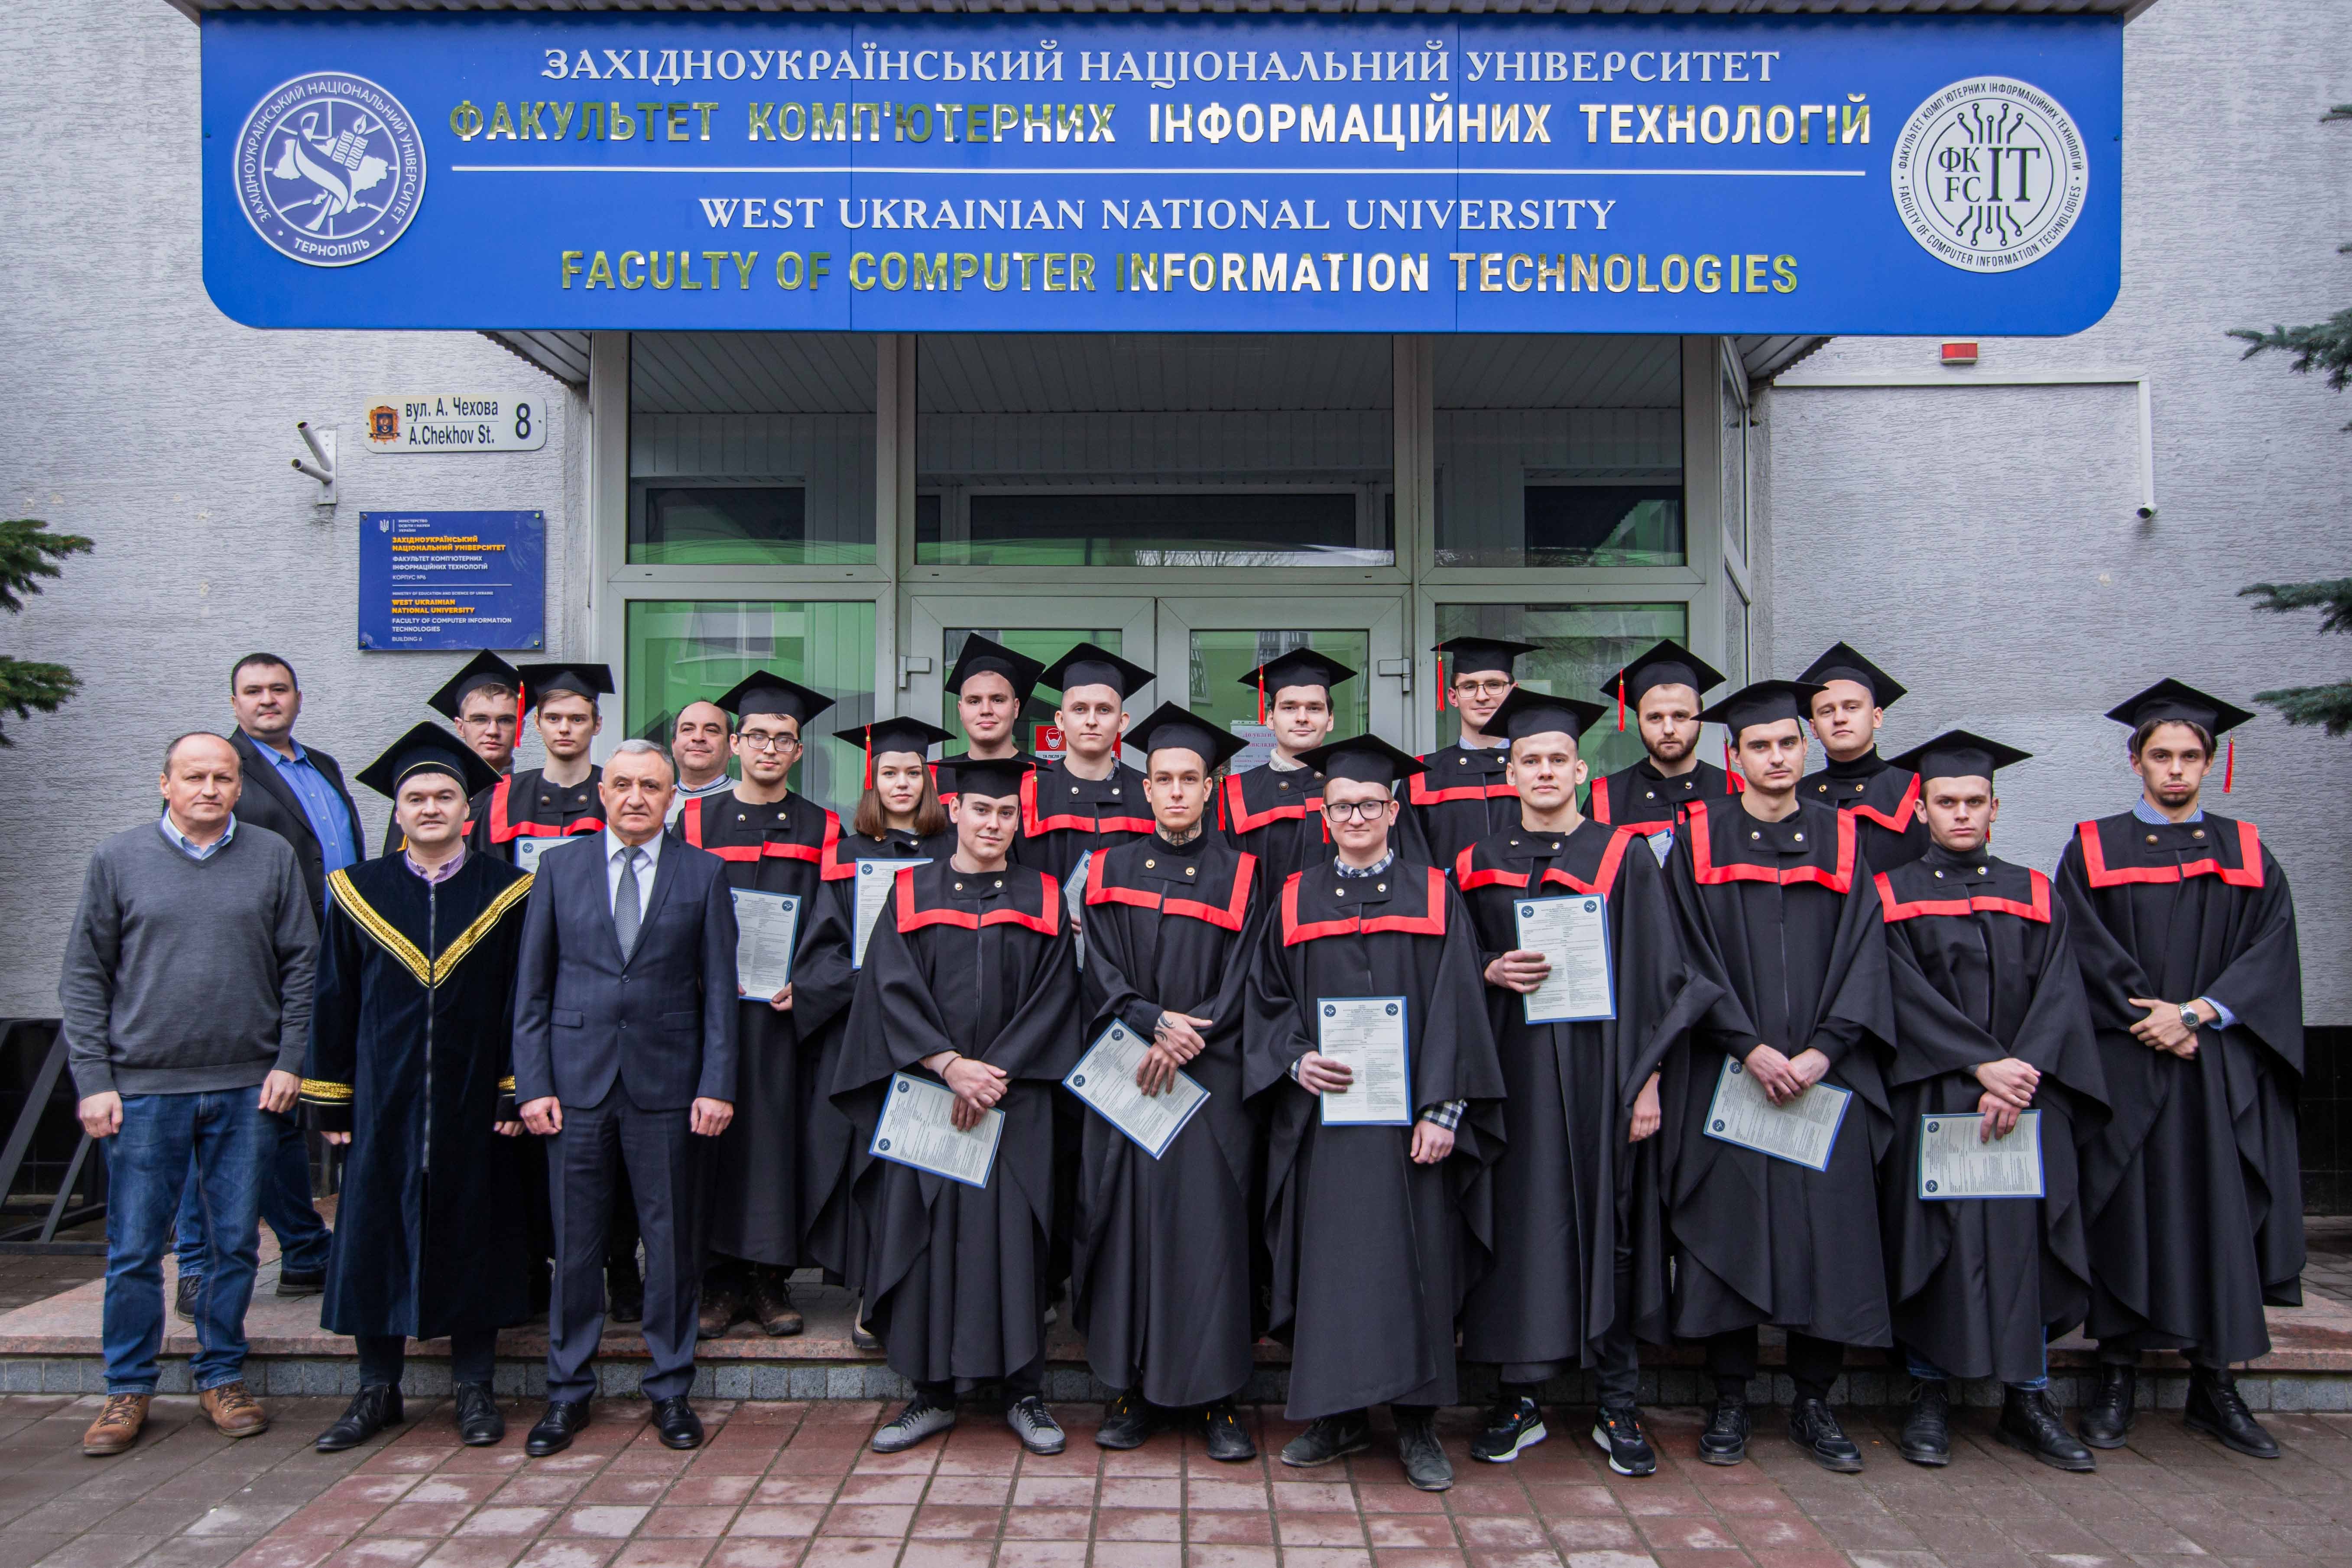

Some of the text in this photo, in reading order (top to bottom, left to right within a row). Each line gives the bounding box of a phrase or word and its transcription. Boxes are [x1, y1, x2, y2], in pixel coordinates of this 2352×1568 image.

[541, 39, 1779, 89] ЗАХІДНОУКРАЇНСЬКИЙ НАЦІОНАЛЬНИЙ УНІВЕРСИТЕТ
[450, 93, 1870, 152] ФАКУЛЬТЕТ КОМП'ЮТЕРНИХ ІНФОРМАЦІЙНИХ ТЕХНОЛОГІЙ
[1898, 83, 2085, 171] ФАКУЛЬТЕТ КОМП'ЮТЕРНИХ ІНФОРМАЦІЙНИХ ТЕХНОЛОГІЙ
[244, 81, 418, 224] ЗАХІДНОУКРАЇНСЬКИЙ НАЦІОНАЛЬНИЙ УНІВЕРСИТЕТ
[1938, 146, 1981, 173] ФК
[1944, 176, 1981, 203] FC
[1987, 147, 2041, 202] IT
[699, 198, 1616, 230] WEST UKRAINIAN NATIONAL UNIVERSITY
[1898, 185, 2081, 267] FACULTY OF COMPUTER INFORMATION TECHNOLOGIES
[295, 237, 370, 256] ТЕРНОПІЛЬ
[562, 250, 1797, 293] FACULTY OF COMPUTER INFORMATION TECHNOLOGIES
[406, 397, 498, 422] вул. А. Чехова
[515, 403, 532, 440] 8
[478, 424, 494, 444] St.
[392, 536, 478, 544] ЗАХІДНОУКРАЇНСЬКИЙ
[392, 544, 453, 552] НАЦІОНАЛЬНИЙ
